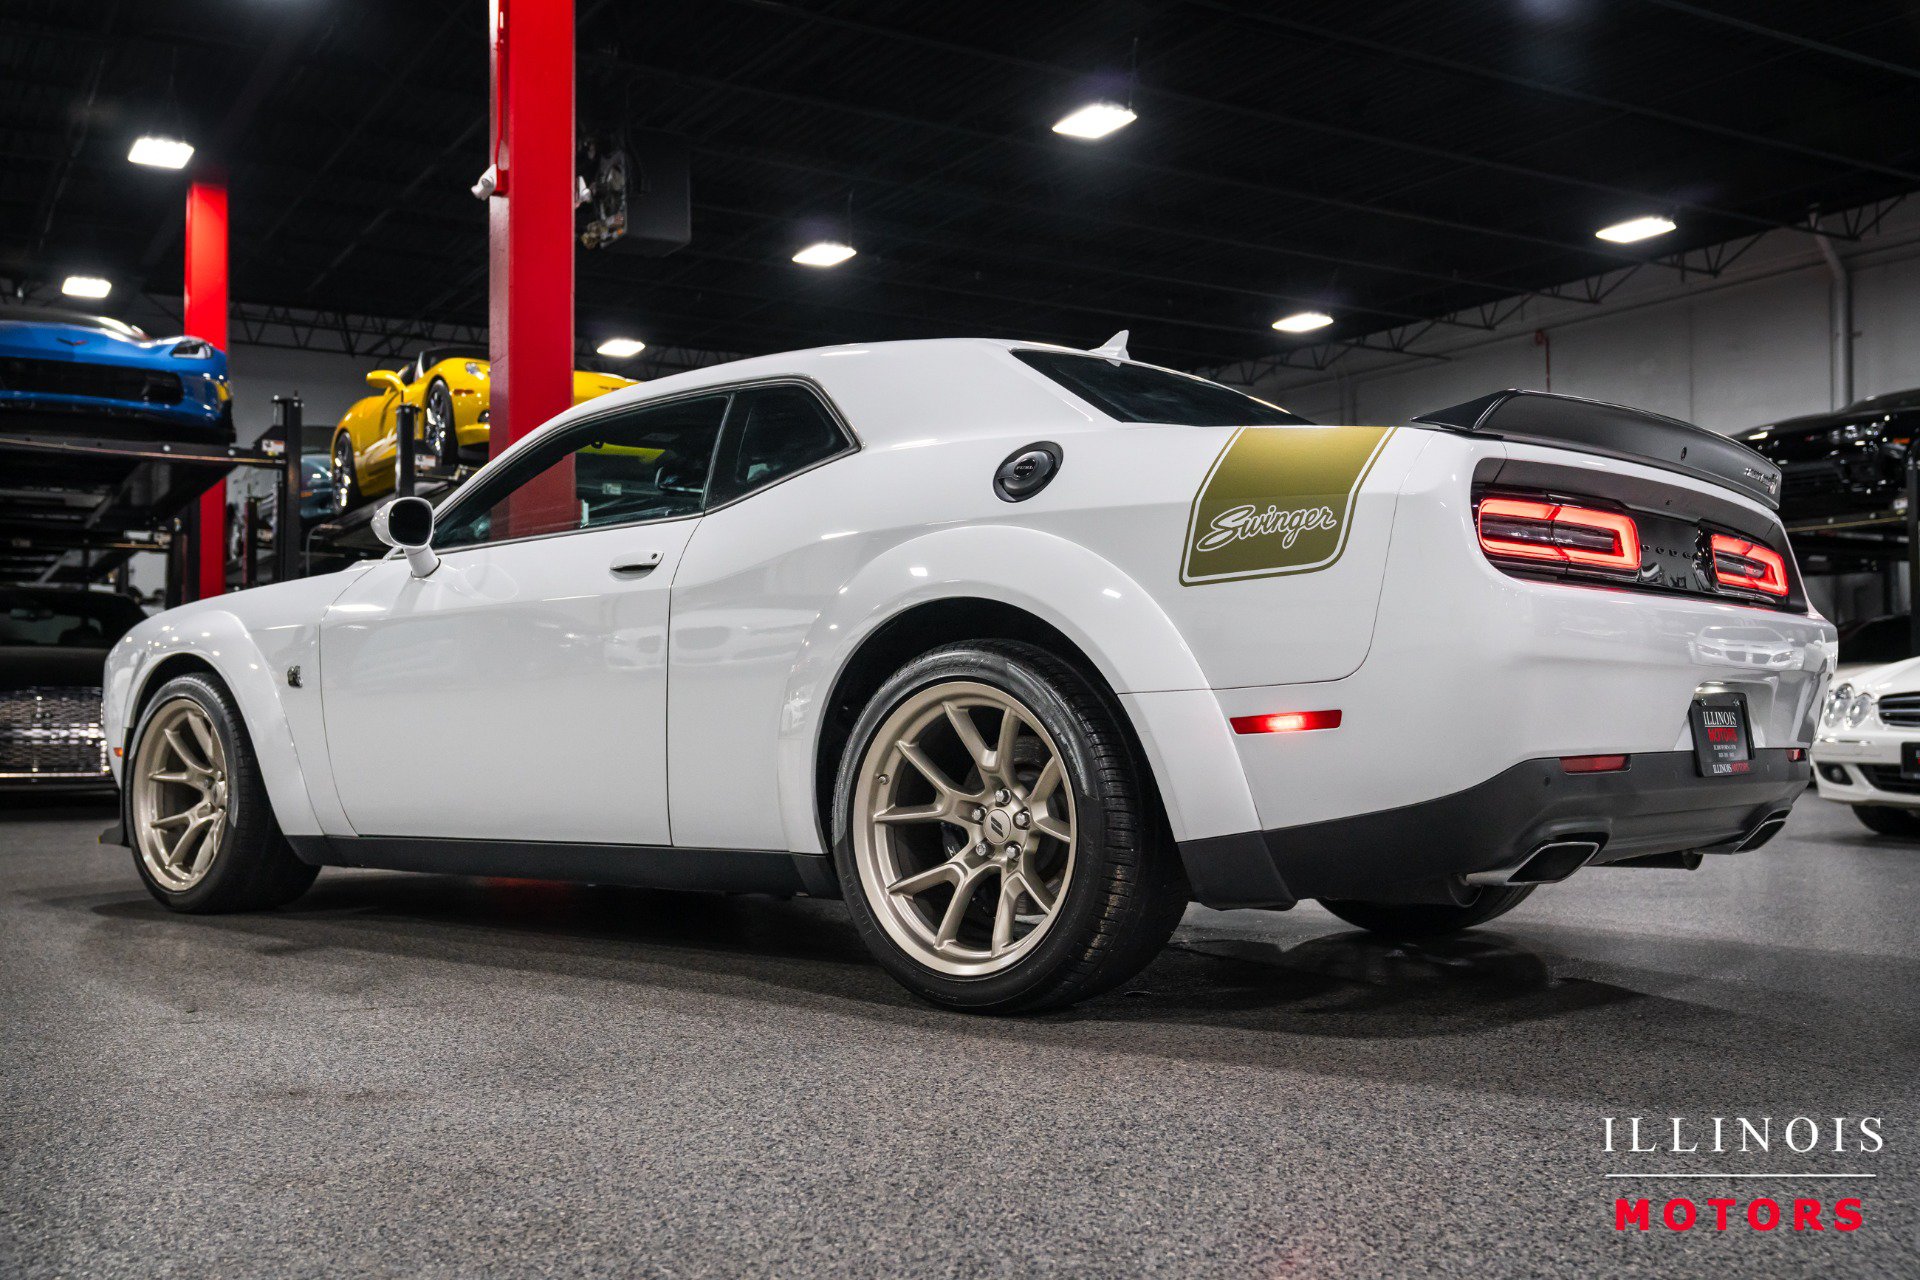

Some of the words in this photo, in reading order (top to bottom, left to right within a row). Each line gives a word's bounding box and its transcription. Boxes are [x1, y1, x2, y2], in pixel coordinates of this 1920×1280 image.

[1196, 504, 1338, 552] Swinger
[1702, 711, 1737, 725] ILLINOIS
[1707, 727, 1738, 742] MOTORS
[1712, 763, 1732, 773] ILLINOIS
